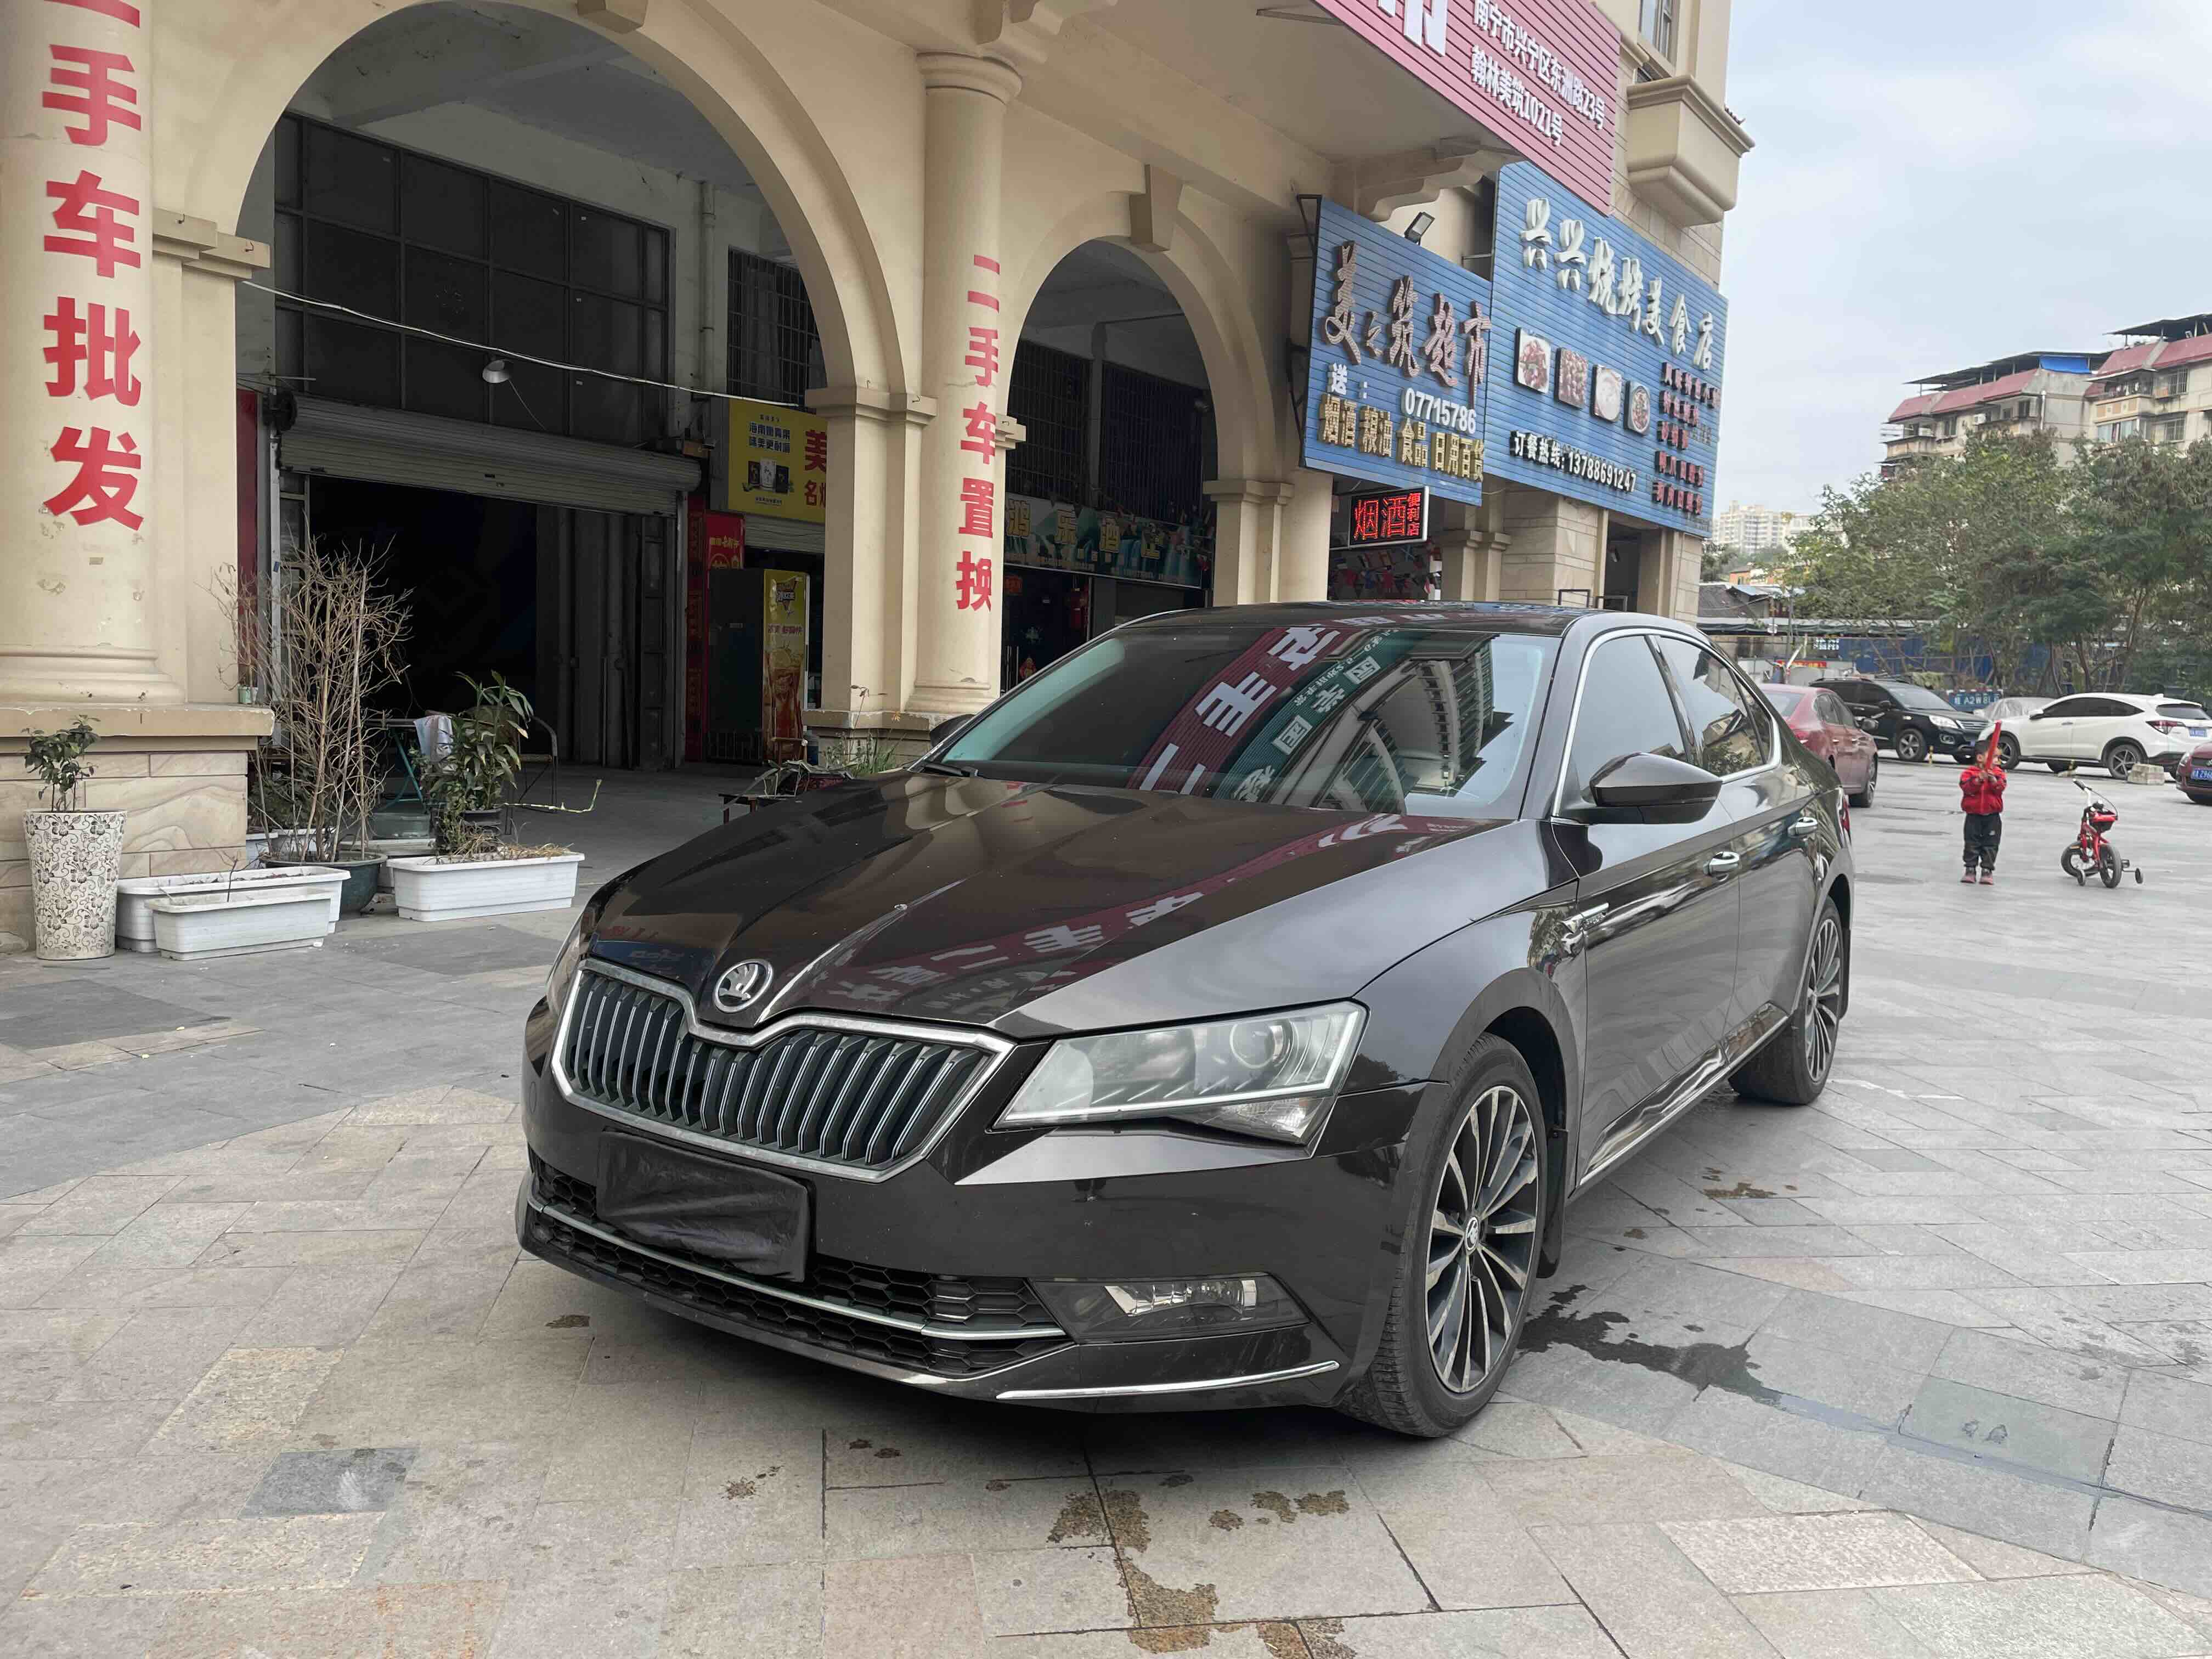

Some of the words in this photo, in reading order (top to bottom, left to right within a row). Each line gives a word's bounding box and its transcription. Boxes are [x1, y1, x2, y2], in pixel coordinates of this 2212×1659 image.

[1470, 46, 1562, 146] 翰林美筑1021号
[956, 254, 1000, 612] 二手车置换
[1322, 394, 1357, 447] 烟酒
[1361, 406, 1393, 457] 粮油
[1400, 418, 1427, 466] 食品
[1434, 432, 1483, 482] 日用百货
[1404, 387, 1477, 435] 07715786
[1353, 494, 1408, 540] 烟酒
